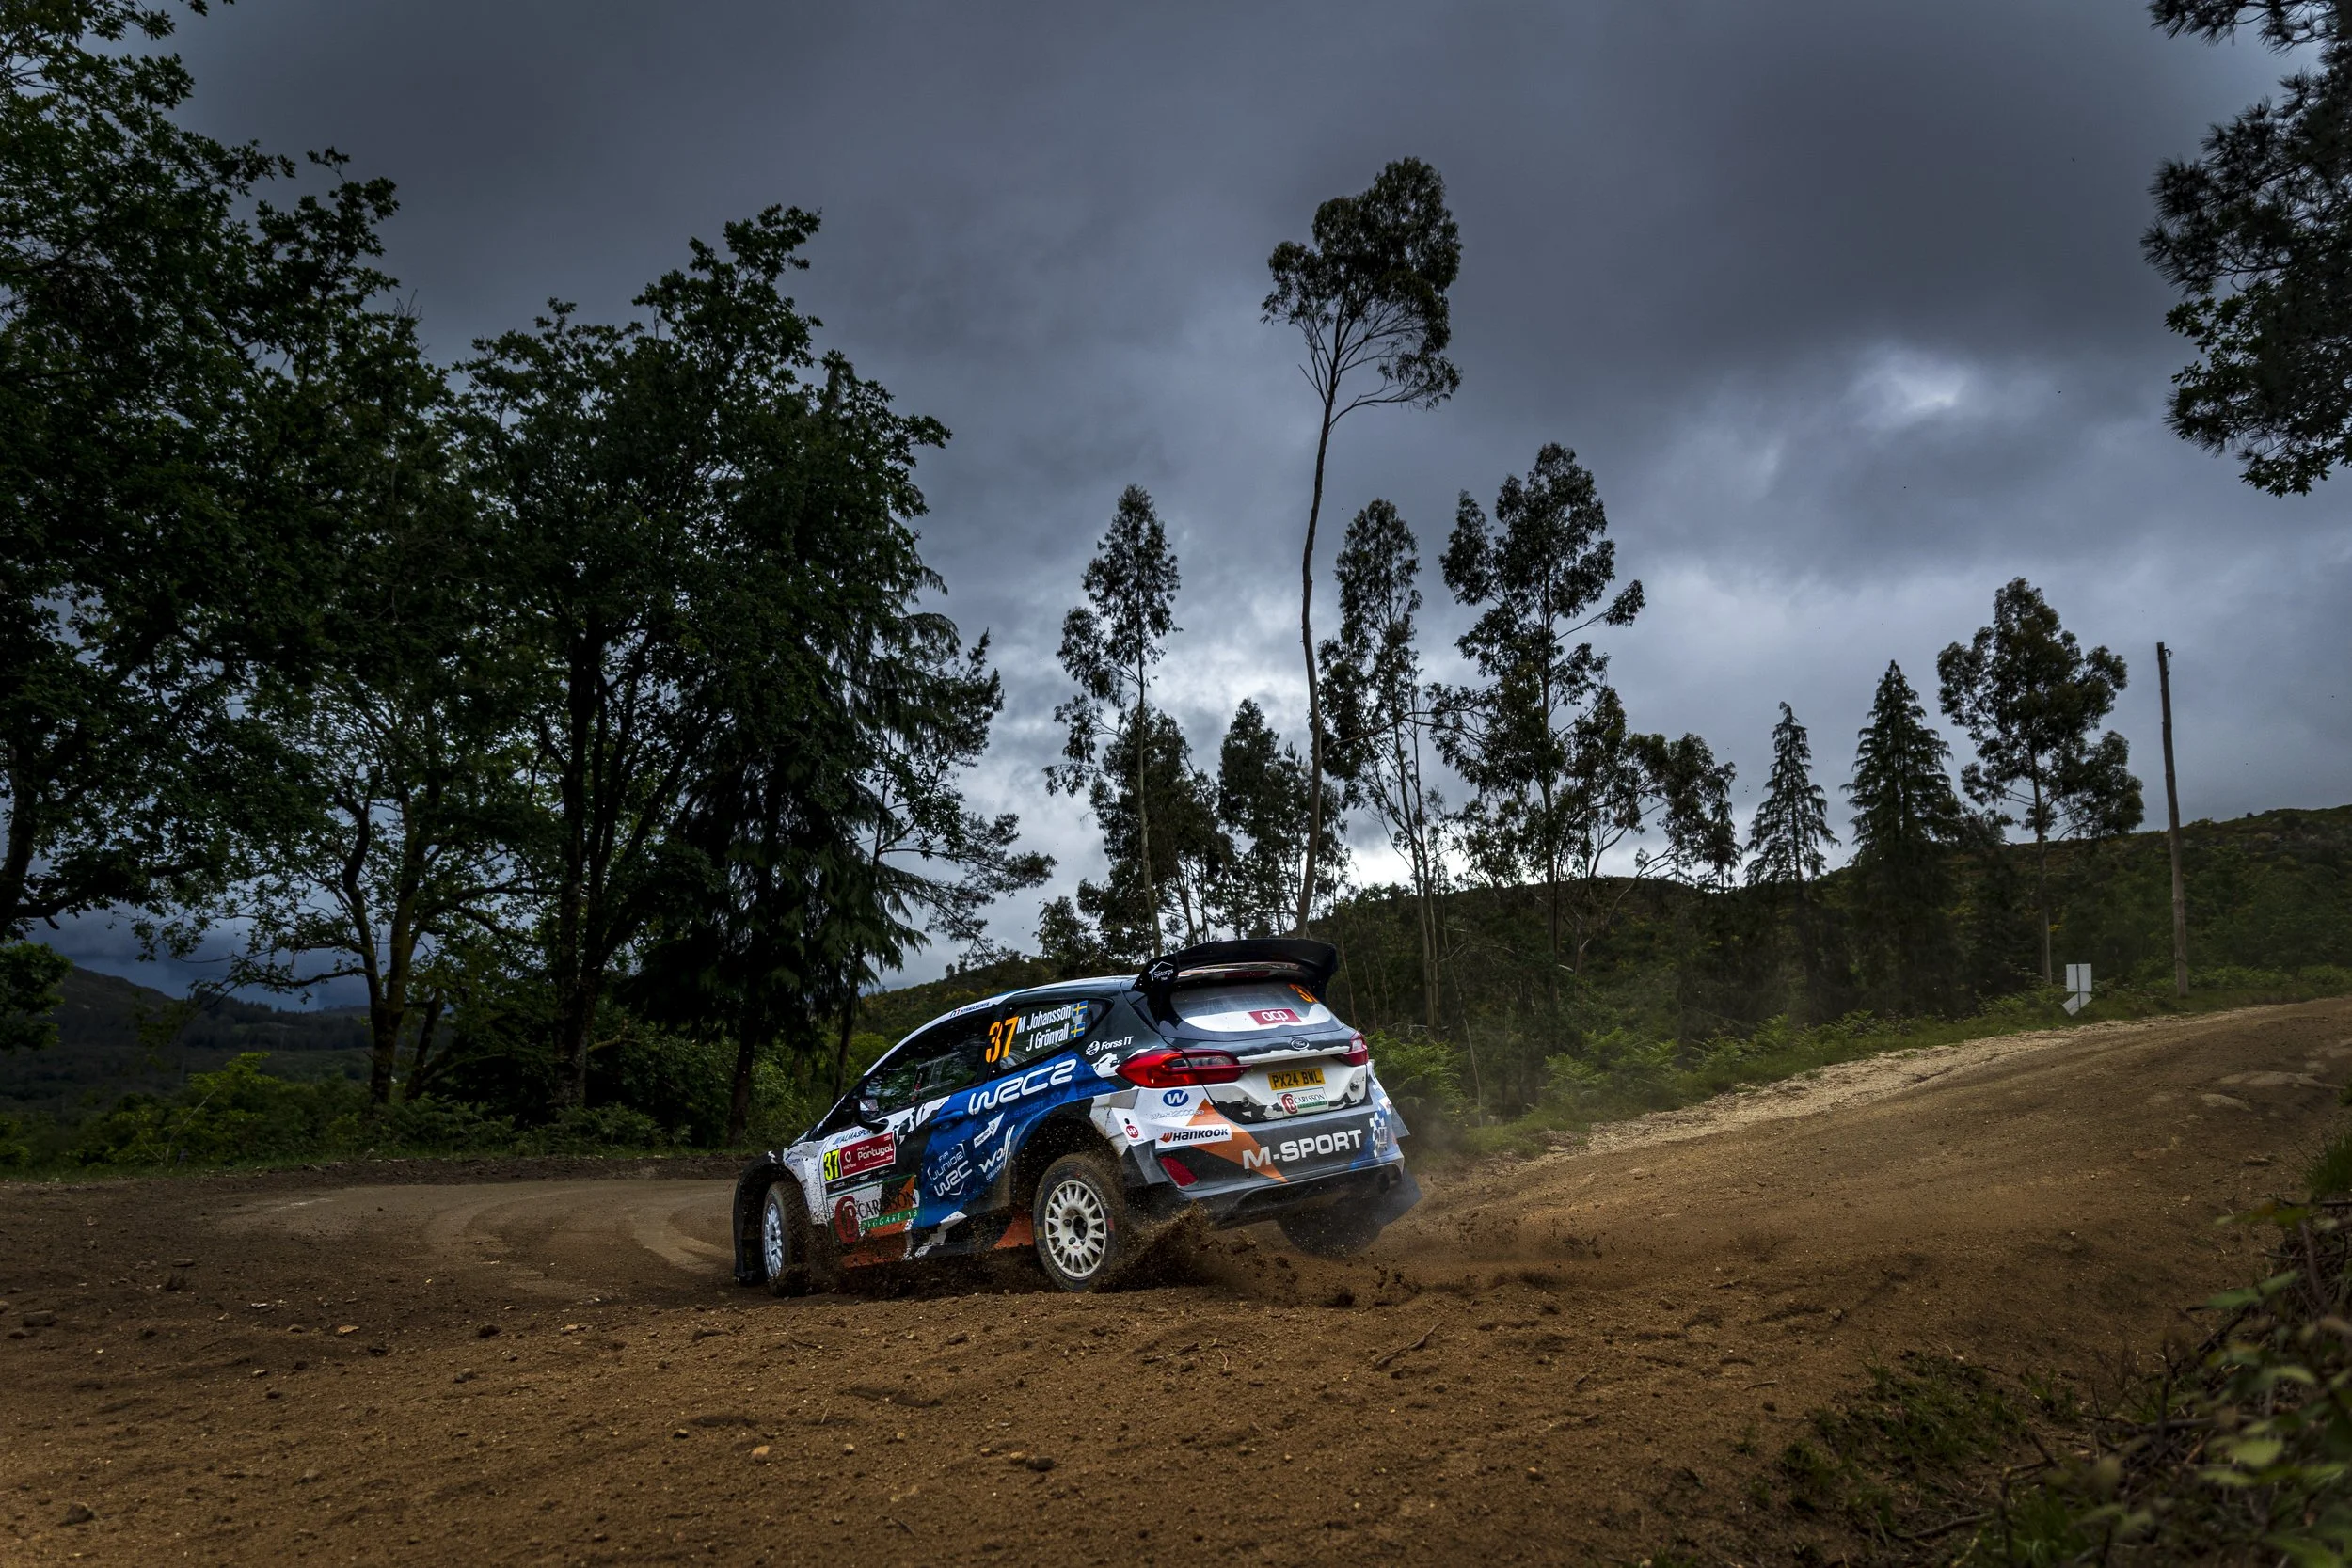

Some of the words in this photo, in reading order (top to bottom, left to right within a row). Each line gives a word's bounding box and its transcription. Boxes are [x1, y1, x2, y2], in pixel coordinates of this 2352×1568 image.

[1016, 1016, 1026, 1034] M
[1026, 1005, 1072, 1031] Johansson
[1261, 1010, 1289, 1022] acp
[985, 1016, 1020, 1064] 37
[1025, 1034, 1034, 1052] J
[1035, 1023, 1070, 1049] Grönvall
[1100, 1039, 1123, 1051] Forss
[1123, 1036, 1135, 1045] IT
[968, 1059, 1077, 1115] WRC2
[1272, 1072, 1299, 1088] PX24
[1167, 1092, 1186, 1104] W
[1294, 1094, 1325, 1104] CARLSSON
[857, 1144, 895, 1161] Portugal
[939, 1151, 949, 1162] FIA
[1242, 1129, 1362, 1169] M-SPORT
[823, 1149, 840, 1181] 37
[932, 1151, 964, 1180] JUNIOR
[934, 1160, 973, 1197] WRC
